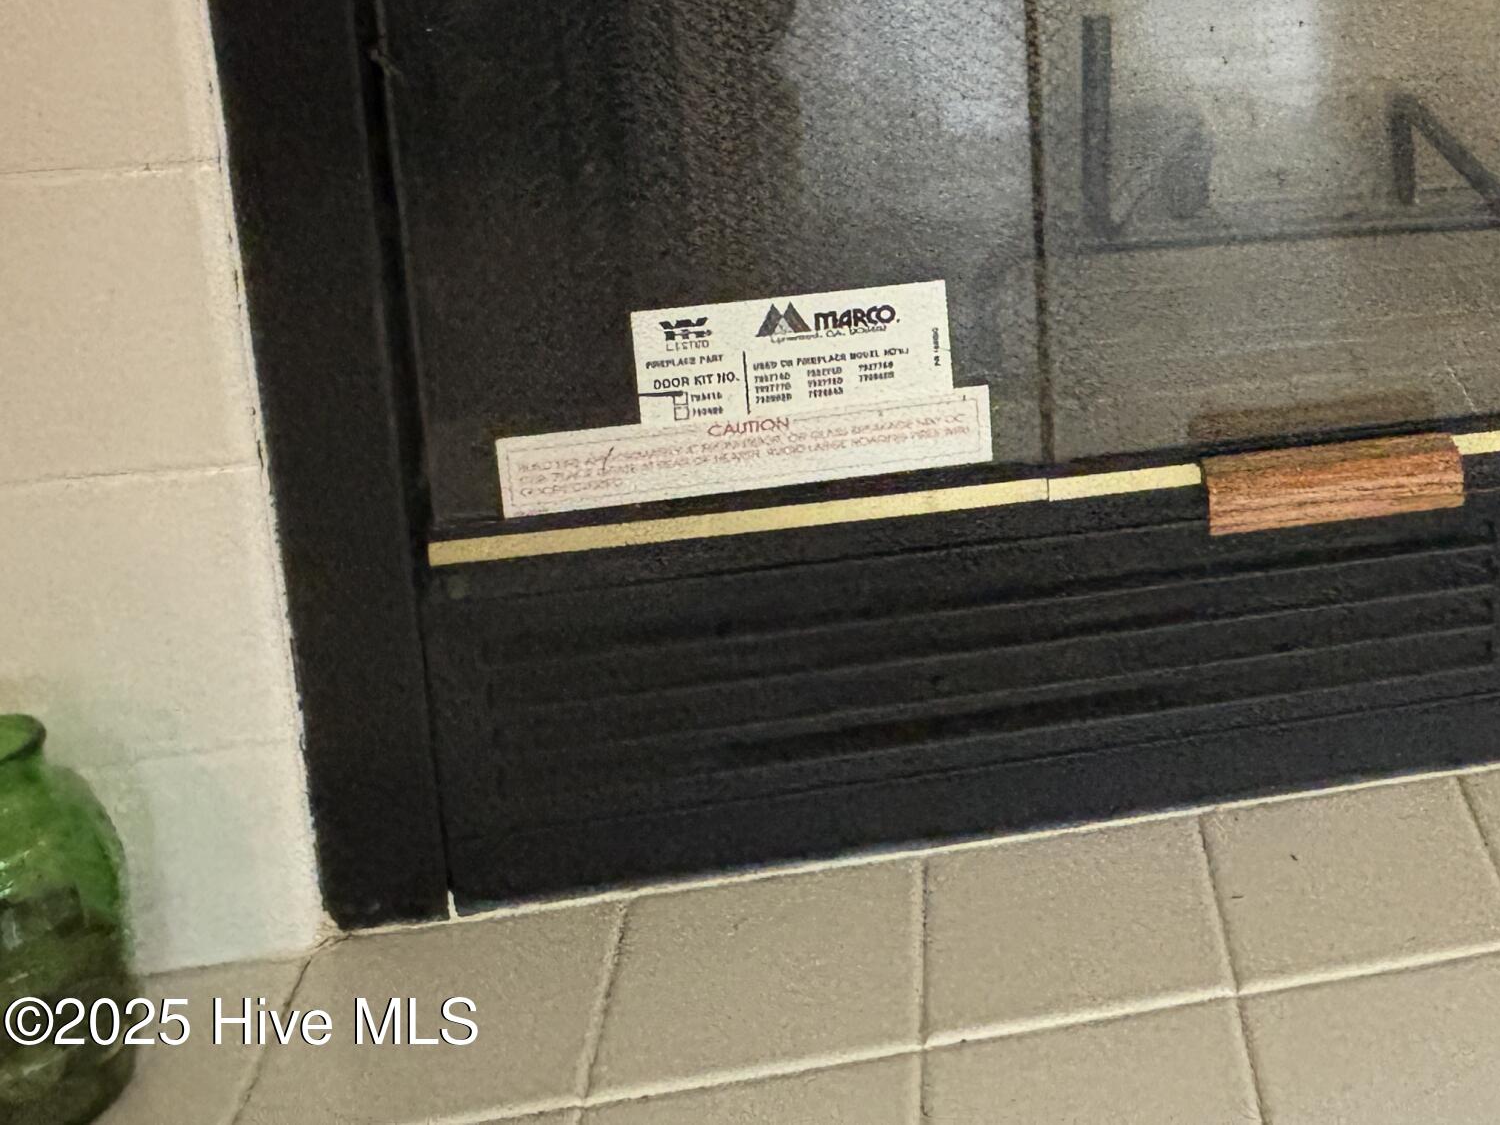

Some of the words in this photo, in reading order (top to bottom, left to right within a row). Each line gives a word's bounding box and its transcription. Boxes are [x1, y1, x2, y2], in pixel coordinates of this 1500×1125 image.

[653, 375, 690, 390] DOOR
[694, 373, 715, 386] KIT
[707, 417, 791, 437] CAUTION
